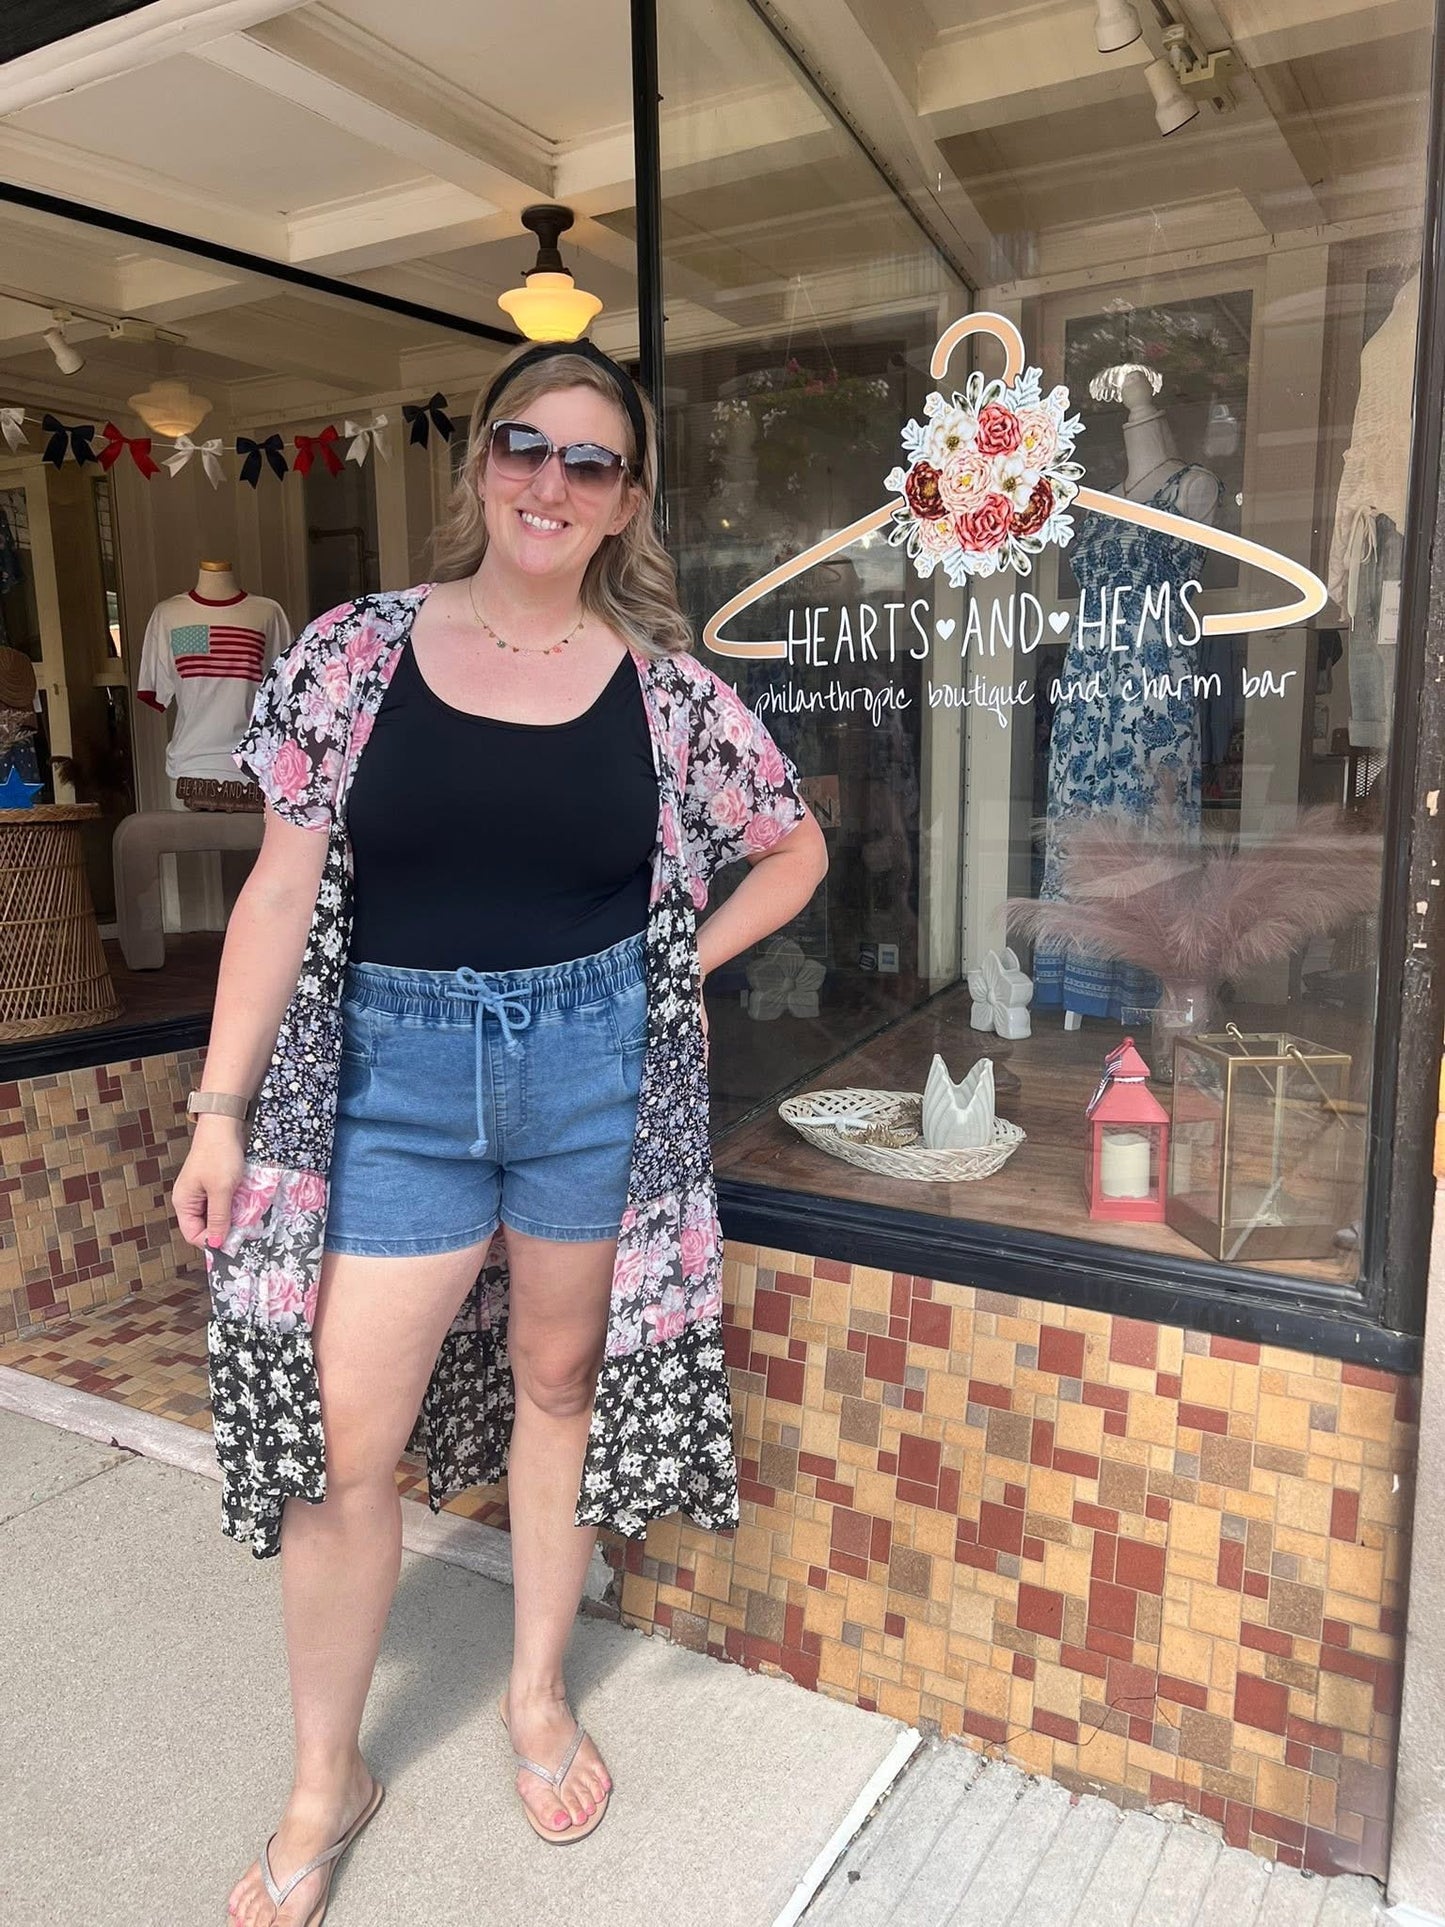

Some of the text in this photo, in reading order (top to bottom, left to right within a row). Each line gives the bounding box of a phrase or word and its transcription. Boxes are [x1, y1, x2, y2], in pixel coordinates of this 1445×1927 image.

[787, 578, 1204, 668] HEARTS AND HEMS
[754, 680, 913, 728] philanthropic
[928, 674, 1036, 730] boutique
[1049, 670, 1109, 706] and
[1121, 667, 1222, 703] charm
[1241, 667, 1298, 699] bar
[179, 778, 217, 798] HEARTS
[222, 781, 242, 800] AND
